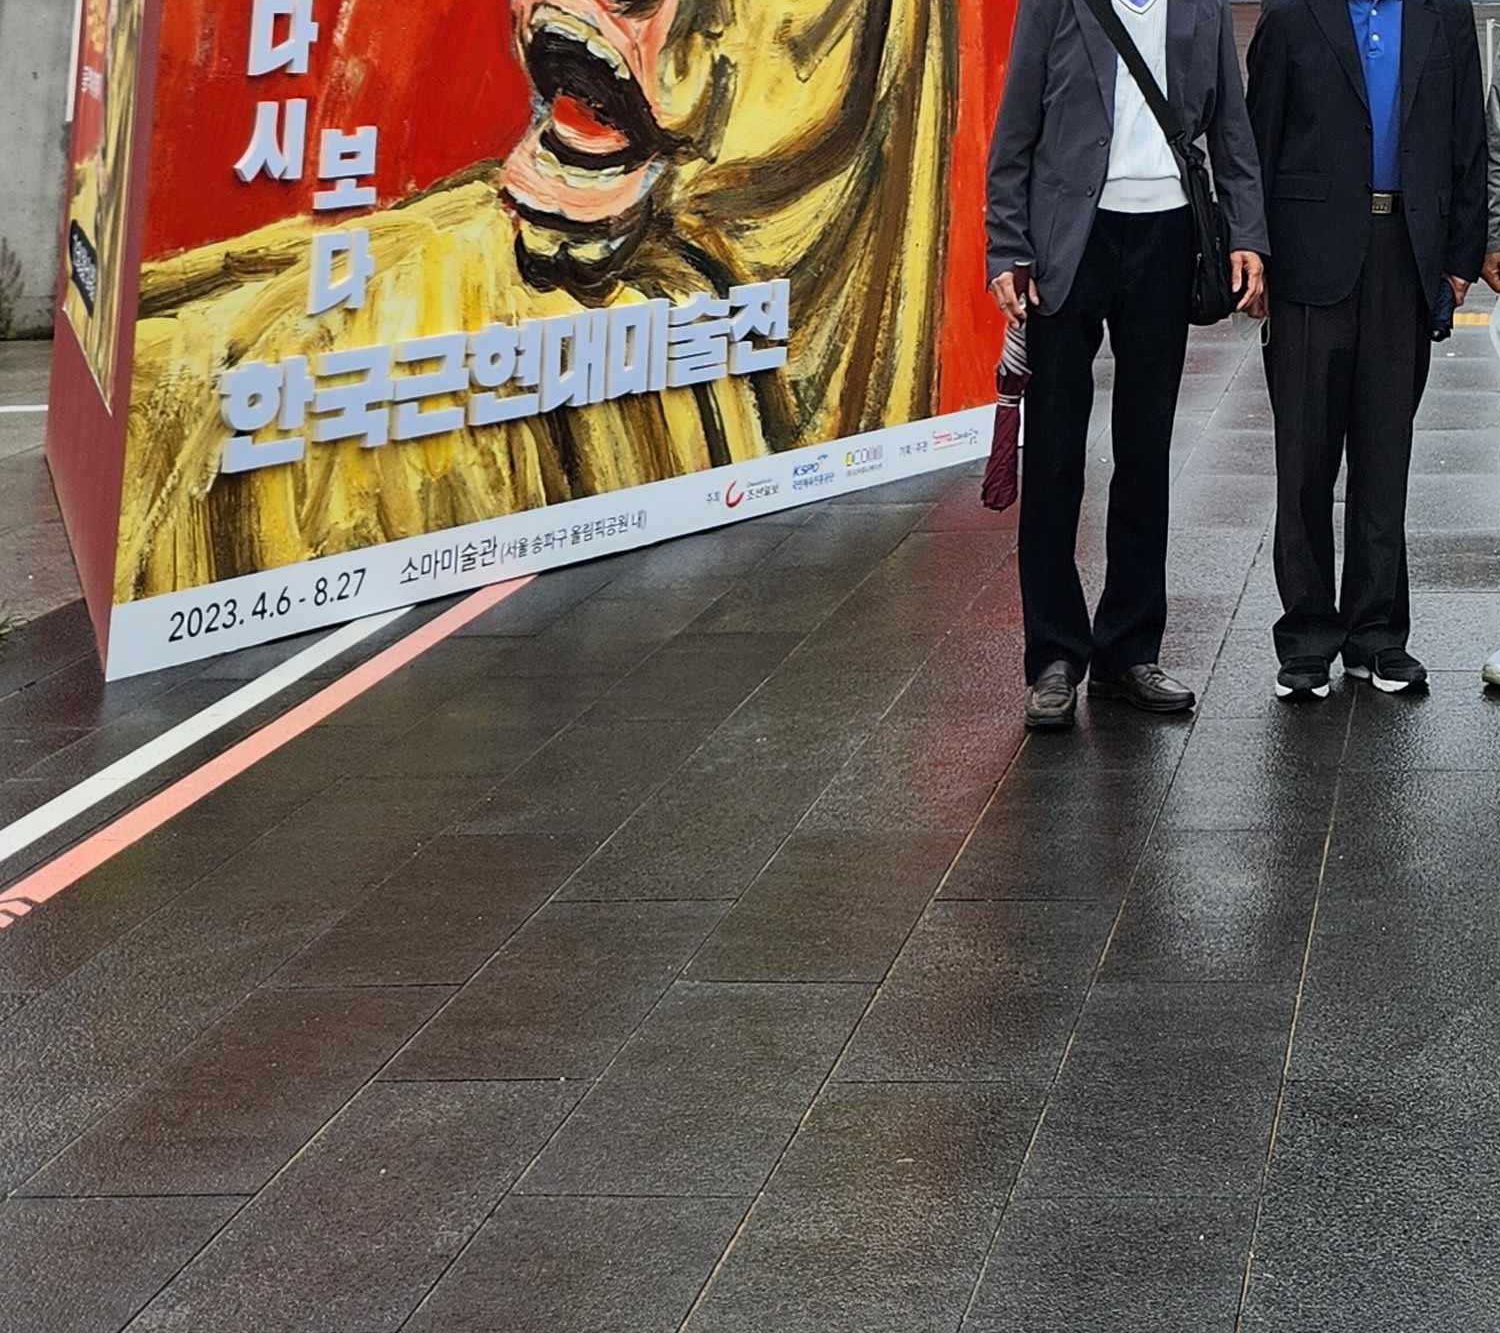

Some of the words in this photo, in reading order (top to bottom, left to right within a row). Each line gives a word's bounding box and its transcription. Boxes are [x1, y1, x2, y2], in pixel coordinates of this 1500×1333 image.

[306, 125, 378, 316] 보다
[220, 278, 791, 474] 한국근현대미술전
[792, 460, 820, 478] KSPO
[399, 536, 498, 585] 소마미술관
[500, 537, 529, 565] (서울
[532, 528, 568, 554] 송파구
[570, 512, 630, 546] 올림픽공원
[168, 598, 245, 643] 2023.
[251, 585, 292, 621] 4.6
[313, 567, 367, 608] 8.27
